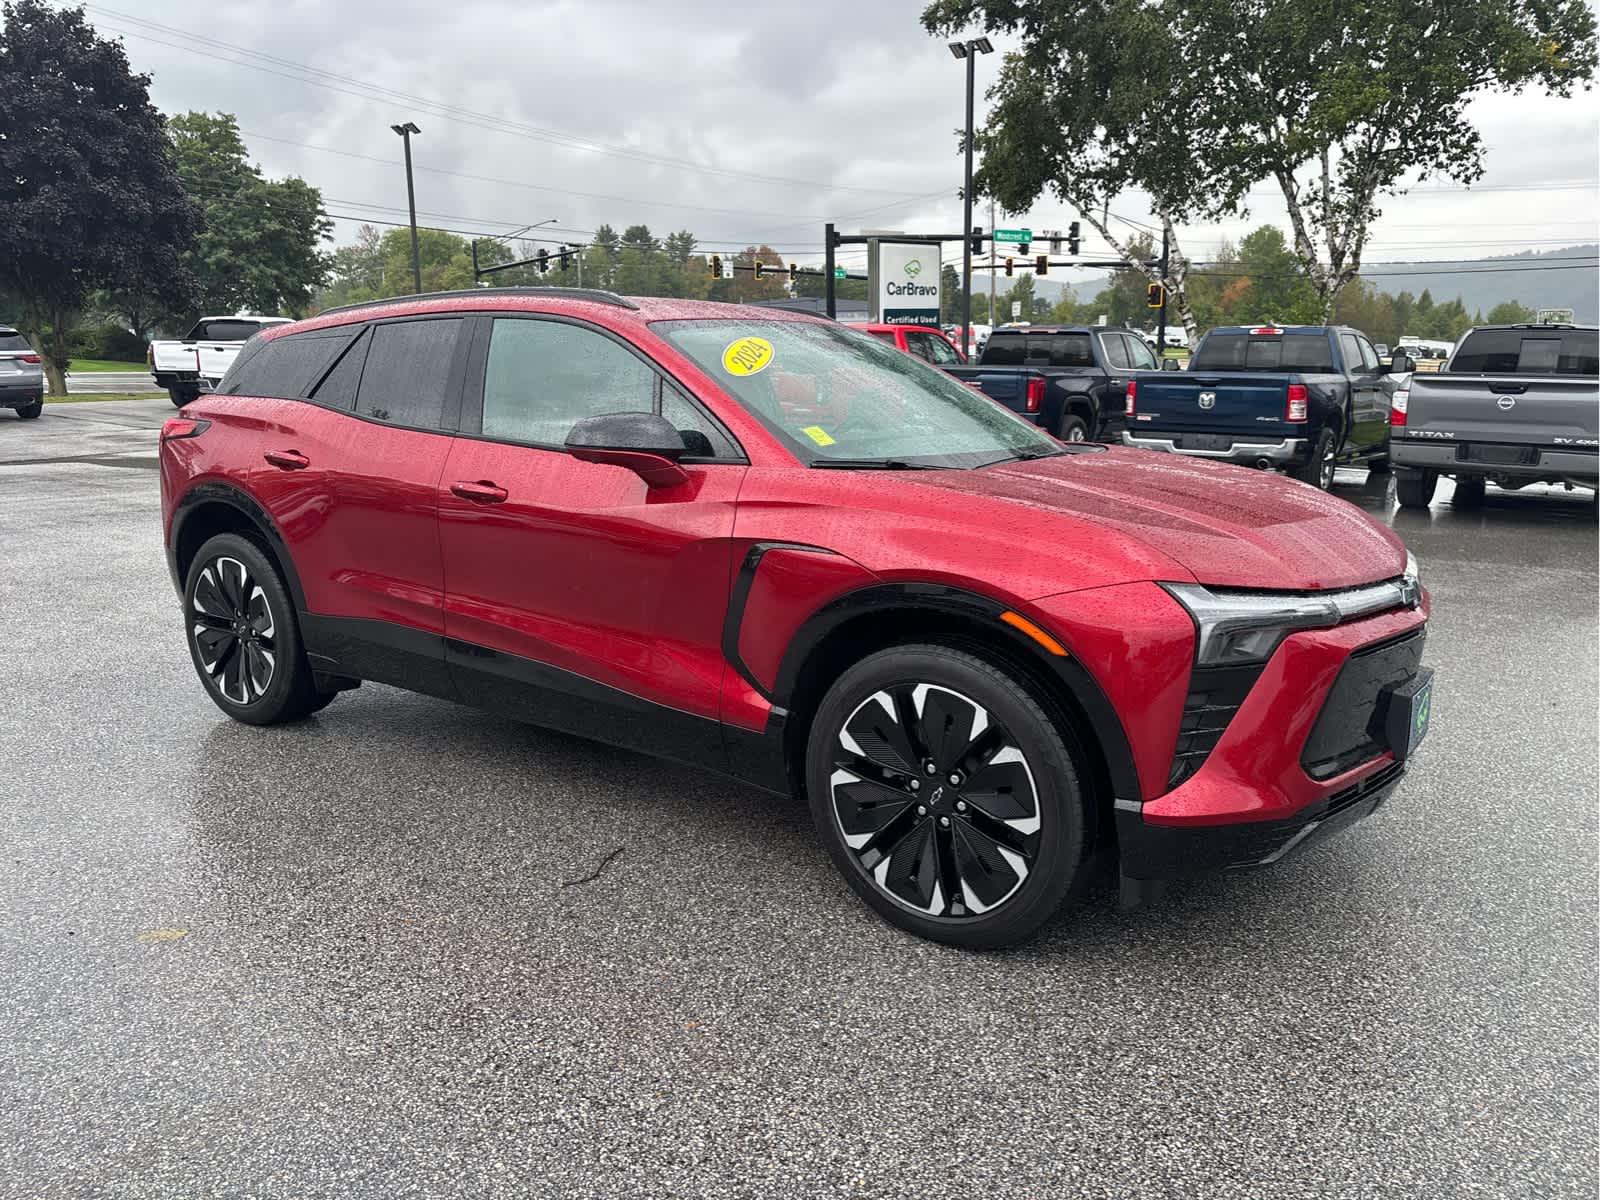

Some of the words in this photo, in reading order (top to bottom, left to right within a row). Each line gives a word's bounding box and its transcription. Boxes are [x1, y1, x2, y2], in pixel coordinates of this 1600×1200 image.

[887, 281, 938, 296] CarBravo
[886, 315, 919, 324] Certified
[920, 315, 937, 324] Used
[731, 340, 768, 370] 2024
[1408, 430, 1455, 439] TITAN
